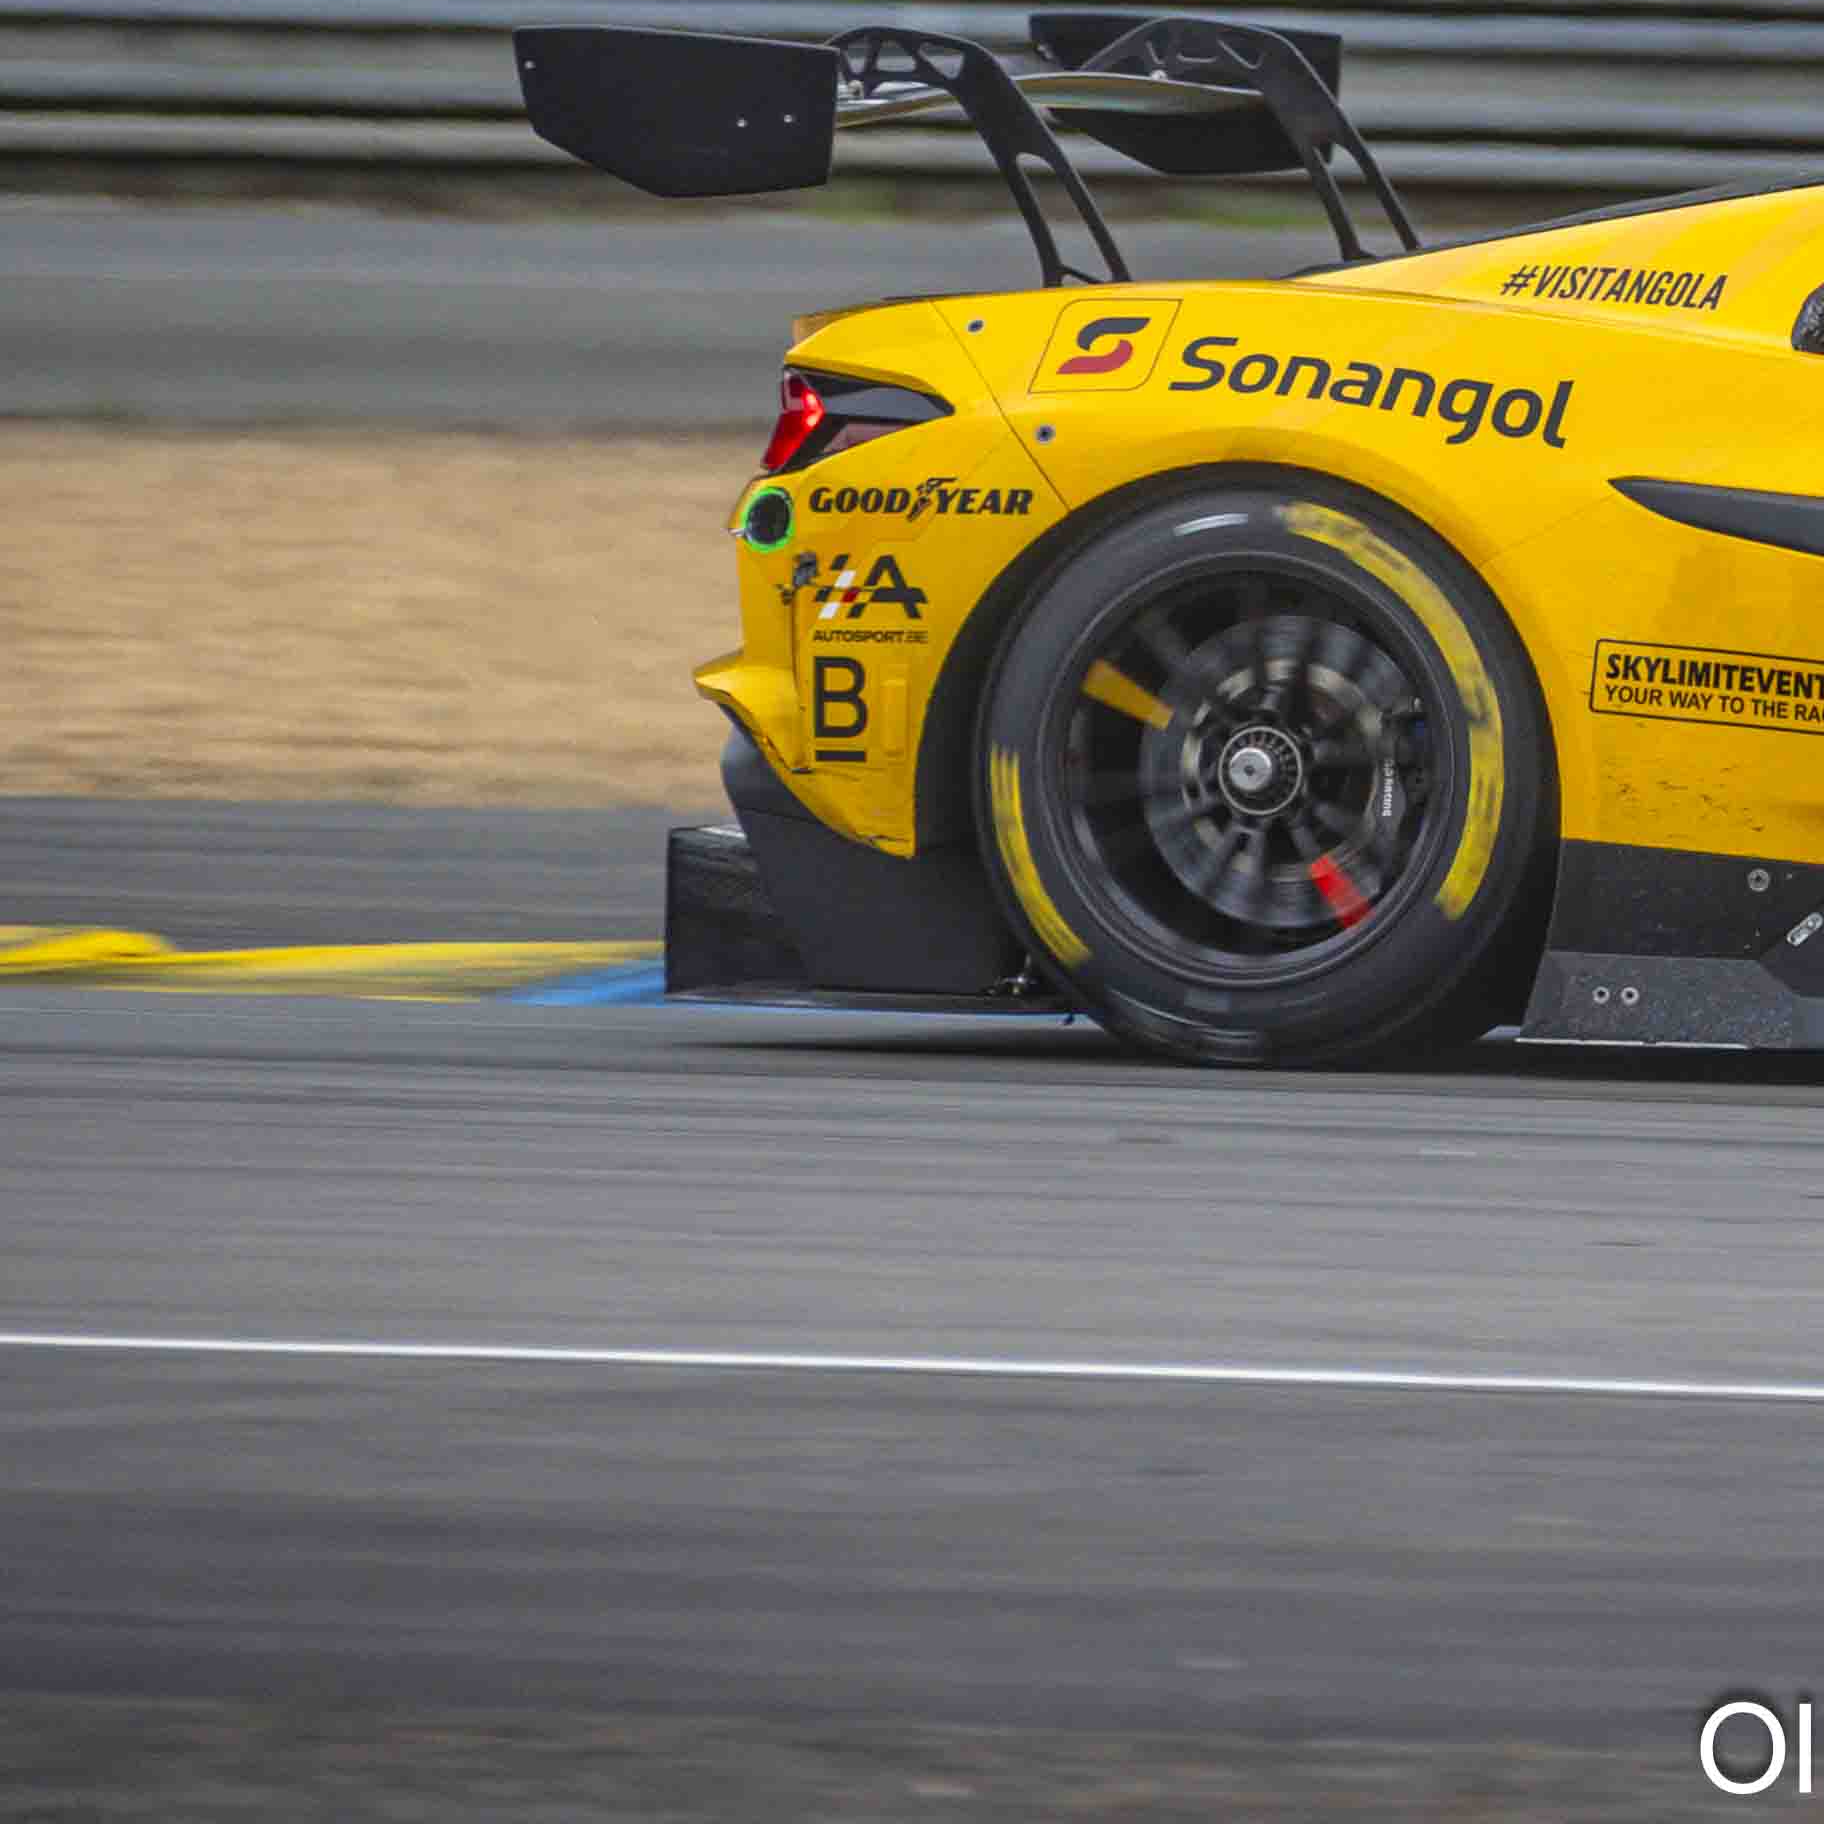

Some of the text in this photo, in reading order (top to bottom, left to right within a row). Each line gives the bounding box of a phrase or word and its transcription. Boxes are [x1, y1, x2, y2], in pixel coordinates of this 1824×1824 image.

[1500, 263, 1729, 311] #VISITANGOLA
[1168, 335, 1575, 449] Sonangol
[809, 477, 1034, 522] GOODYEAR
[1604, 684, 1663, 707] YOUR
[1668, 690, 1714, 712] WAY
[1718, 695, 1745, 715] TO
[1751, 698, 1789, 720] THE
